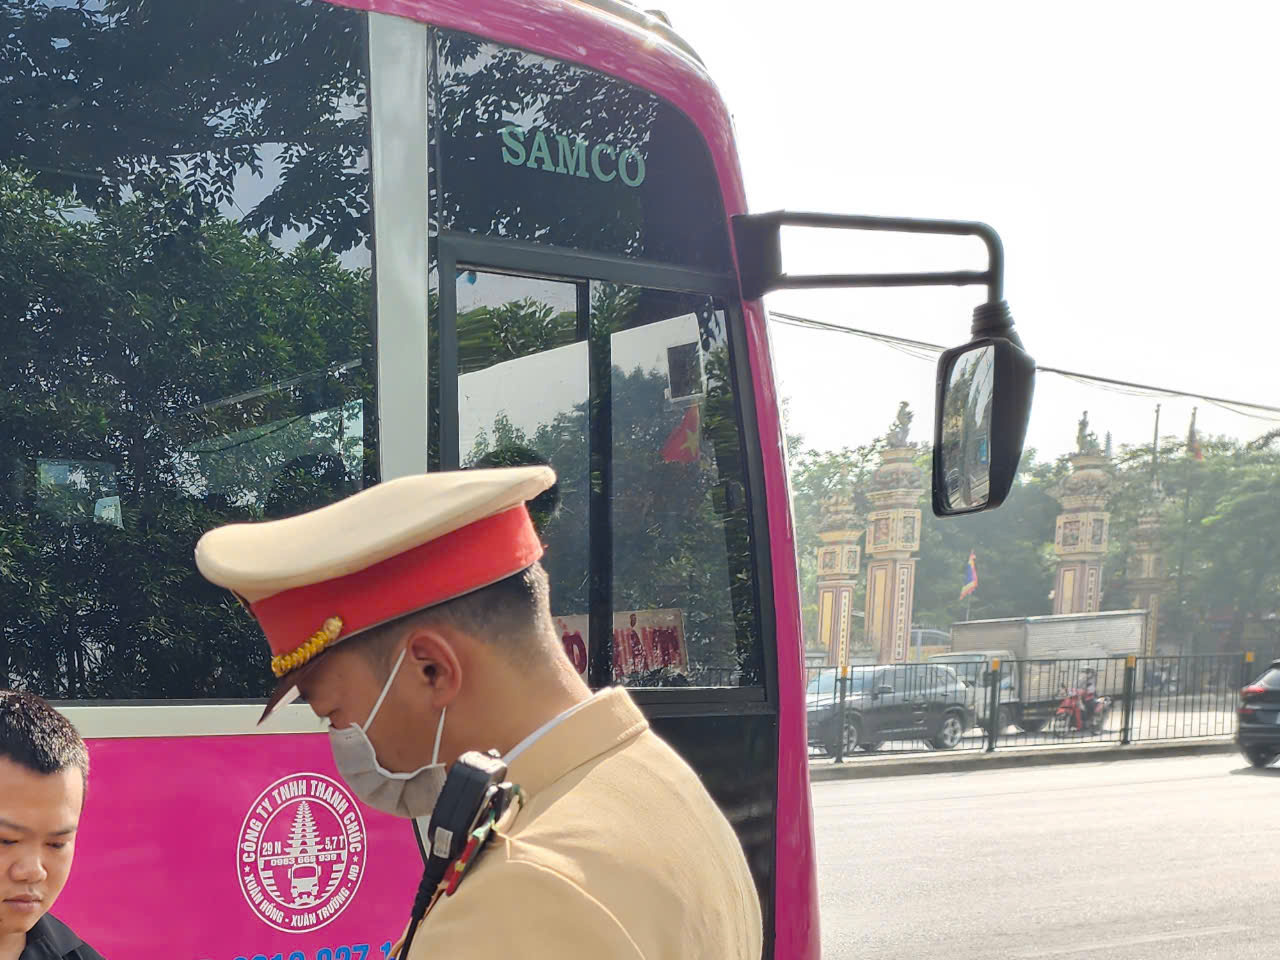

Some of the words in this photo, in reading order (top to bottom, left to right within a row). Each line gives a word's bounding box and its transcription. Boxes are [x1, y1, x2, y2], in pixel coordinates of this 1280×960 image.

[501, 125, 646, 187] SAMCO
[241, 818, 263, 863] CÔNG
[256, 798, 274, 819] TY
[272, 780, 307, 805] TNHH
[310, 780, 349, 815] THANH
[343, 812, 364, 853] CHÚC
[262, 842, 273, 855] 29
[275, 841, 281, 854] N
[291, 912, 317, 927] XUÂN
